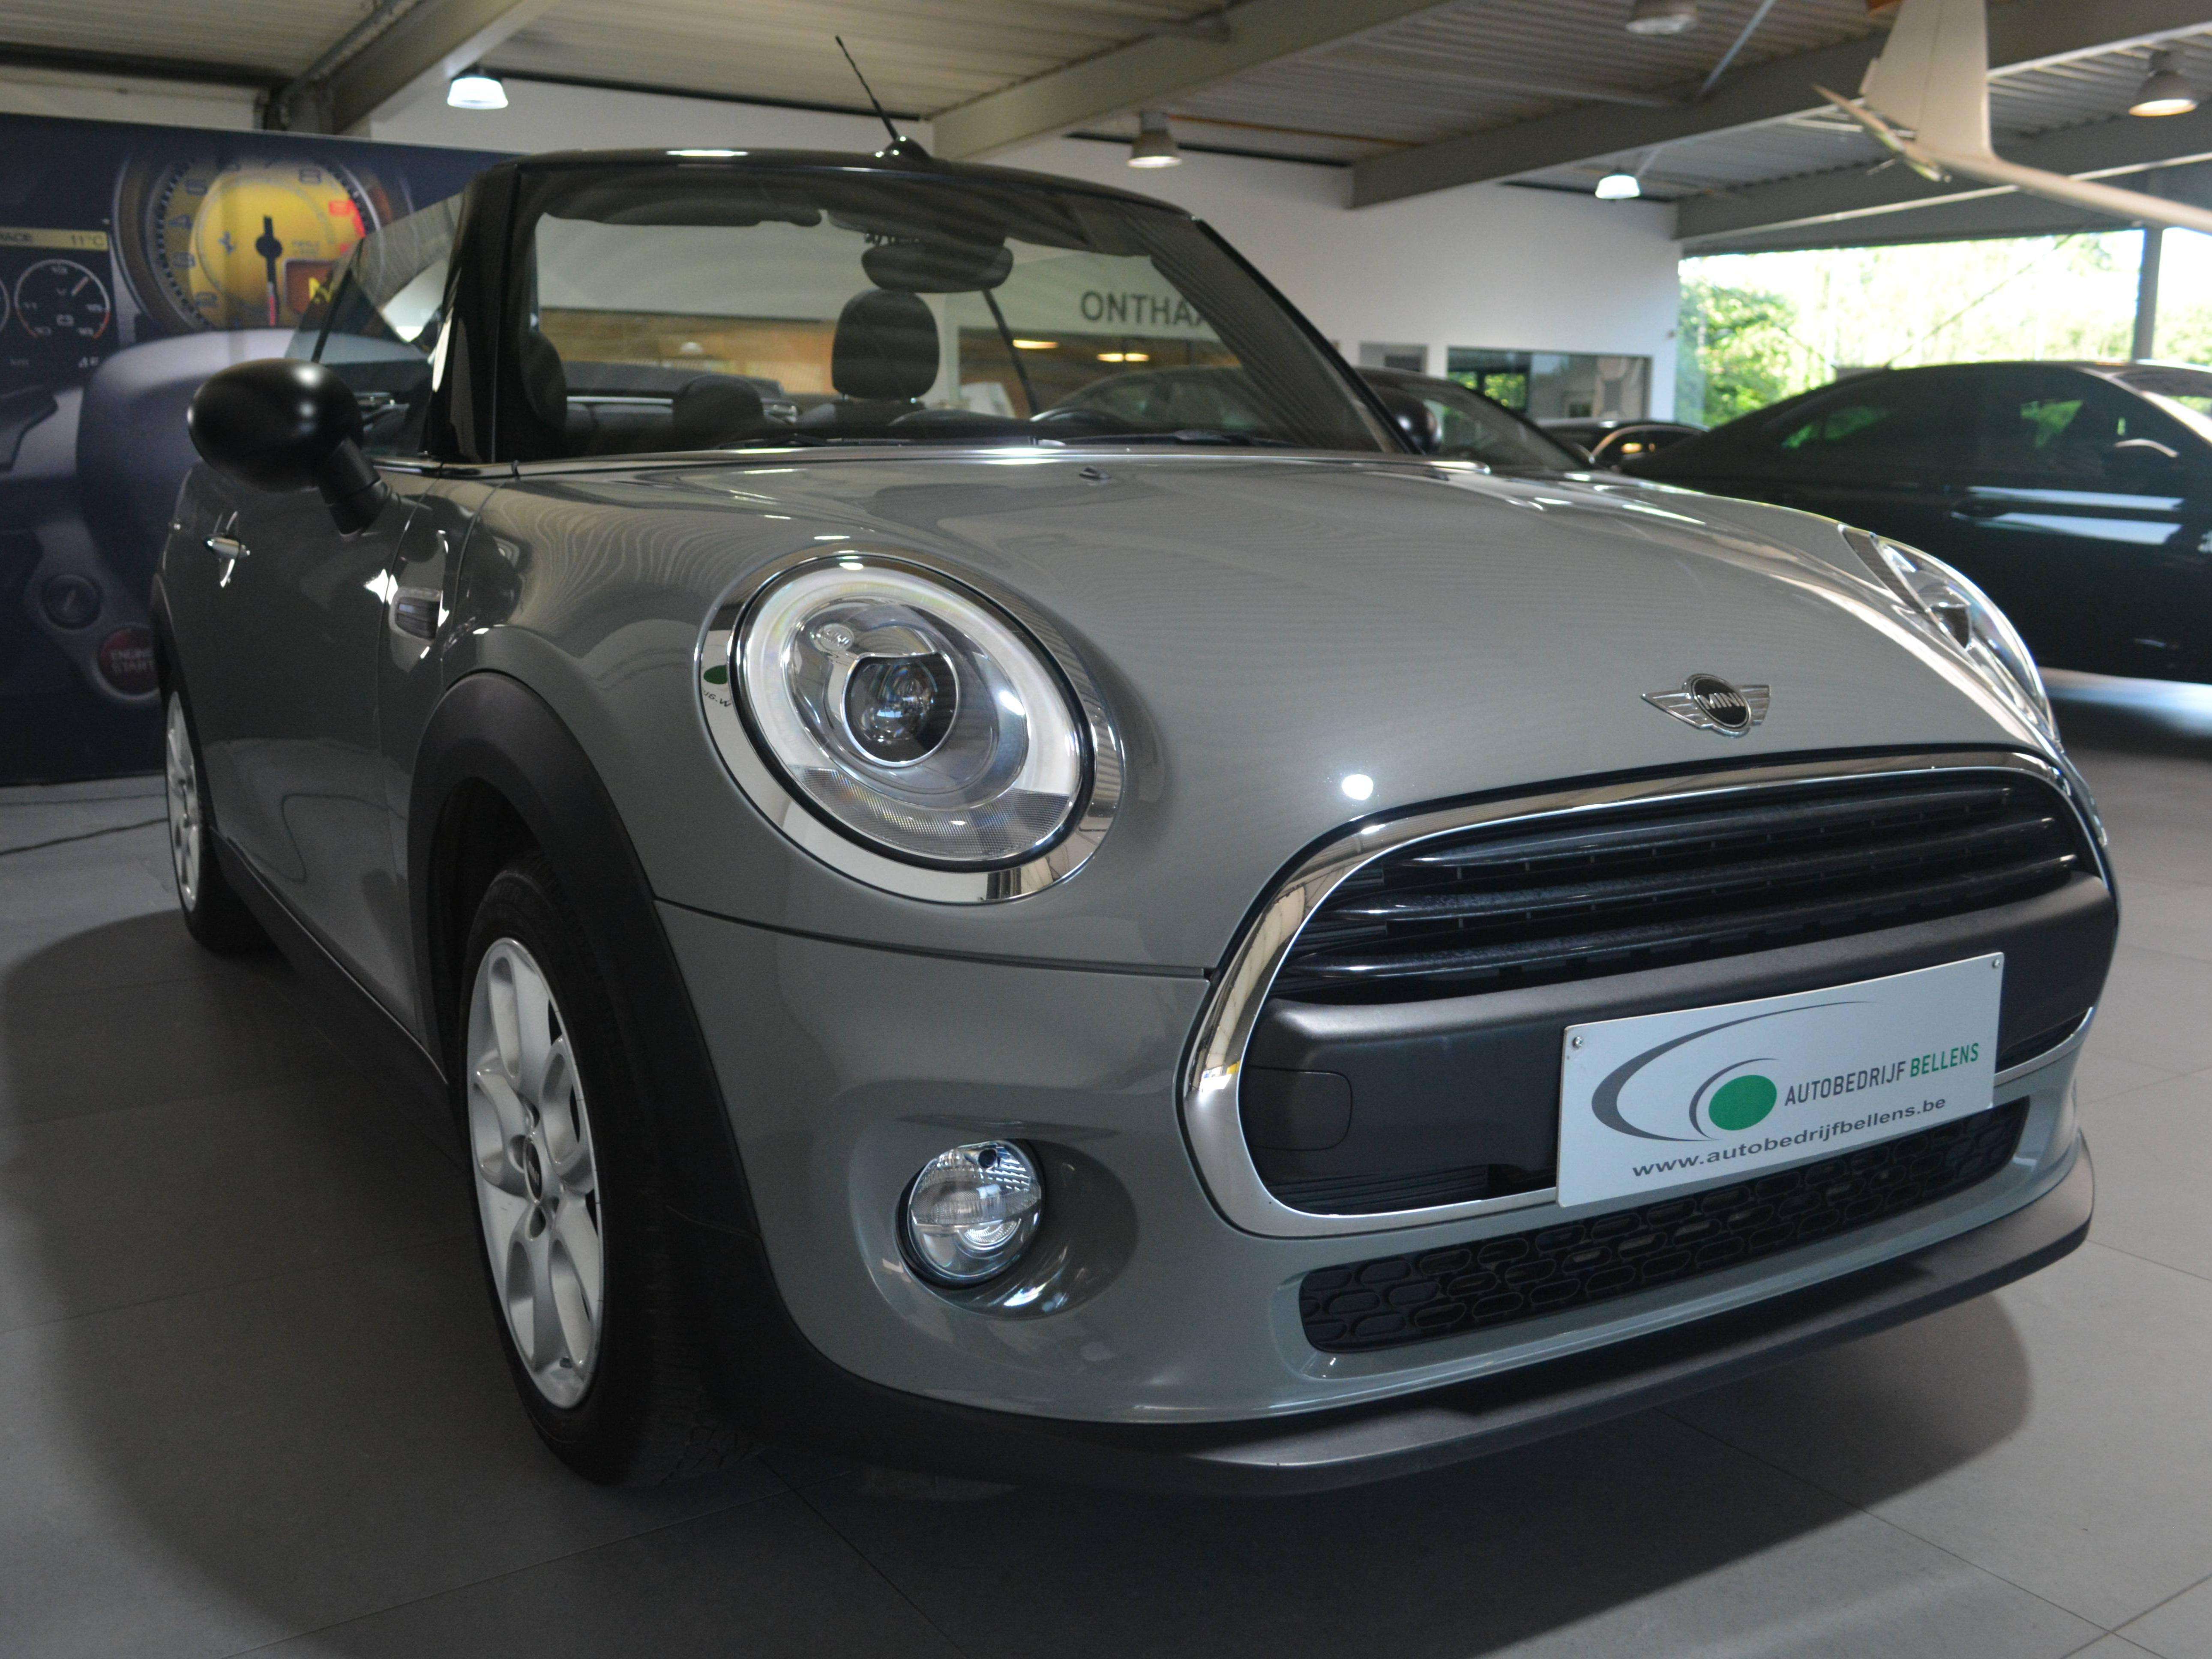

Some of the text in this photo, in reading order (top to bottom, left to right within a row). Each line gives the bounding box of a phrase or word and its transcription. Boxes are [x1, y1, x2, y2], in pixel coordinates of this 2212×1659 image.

[1698, 692, 1745, 710] MINI
[1785, 1042, 1979, 1106] AUTOBEDRIJF BELLENS
[1632, 1098, 1946, 1177] www.autobedrijfbellens.be
